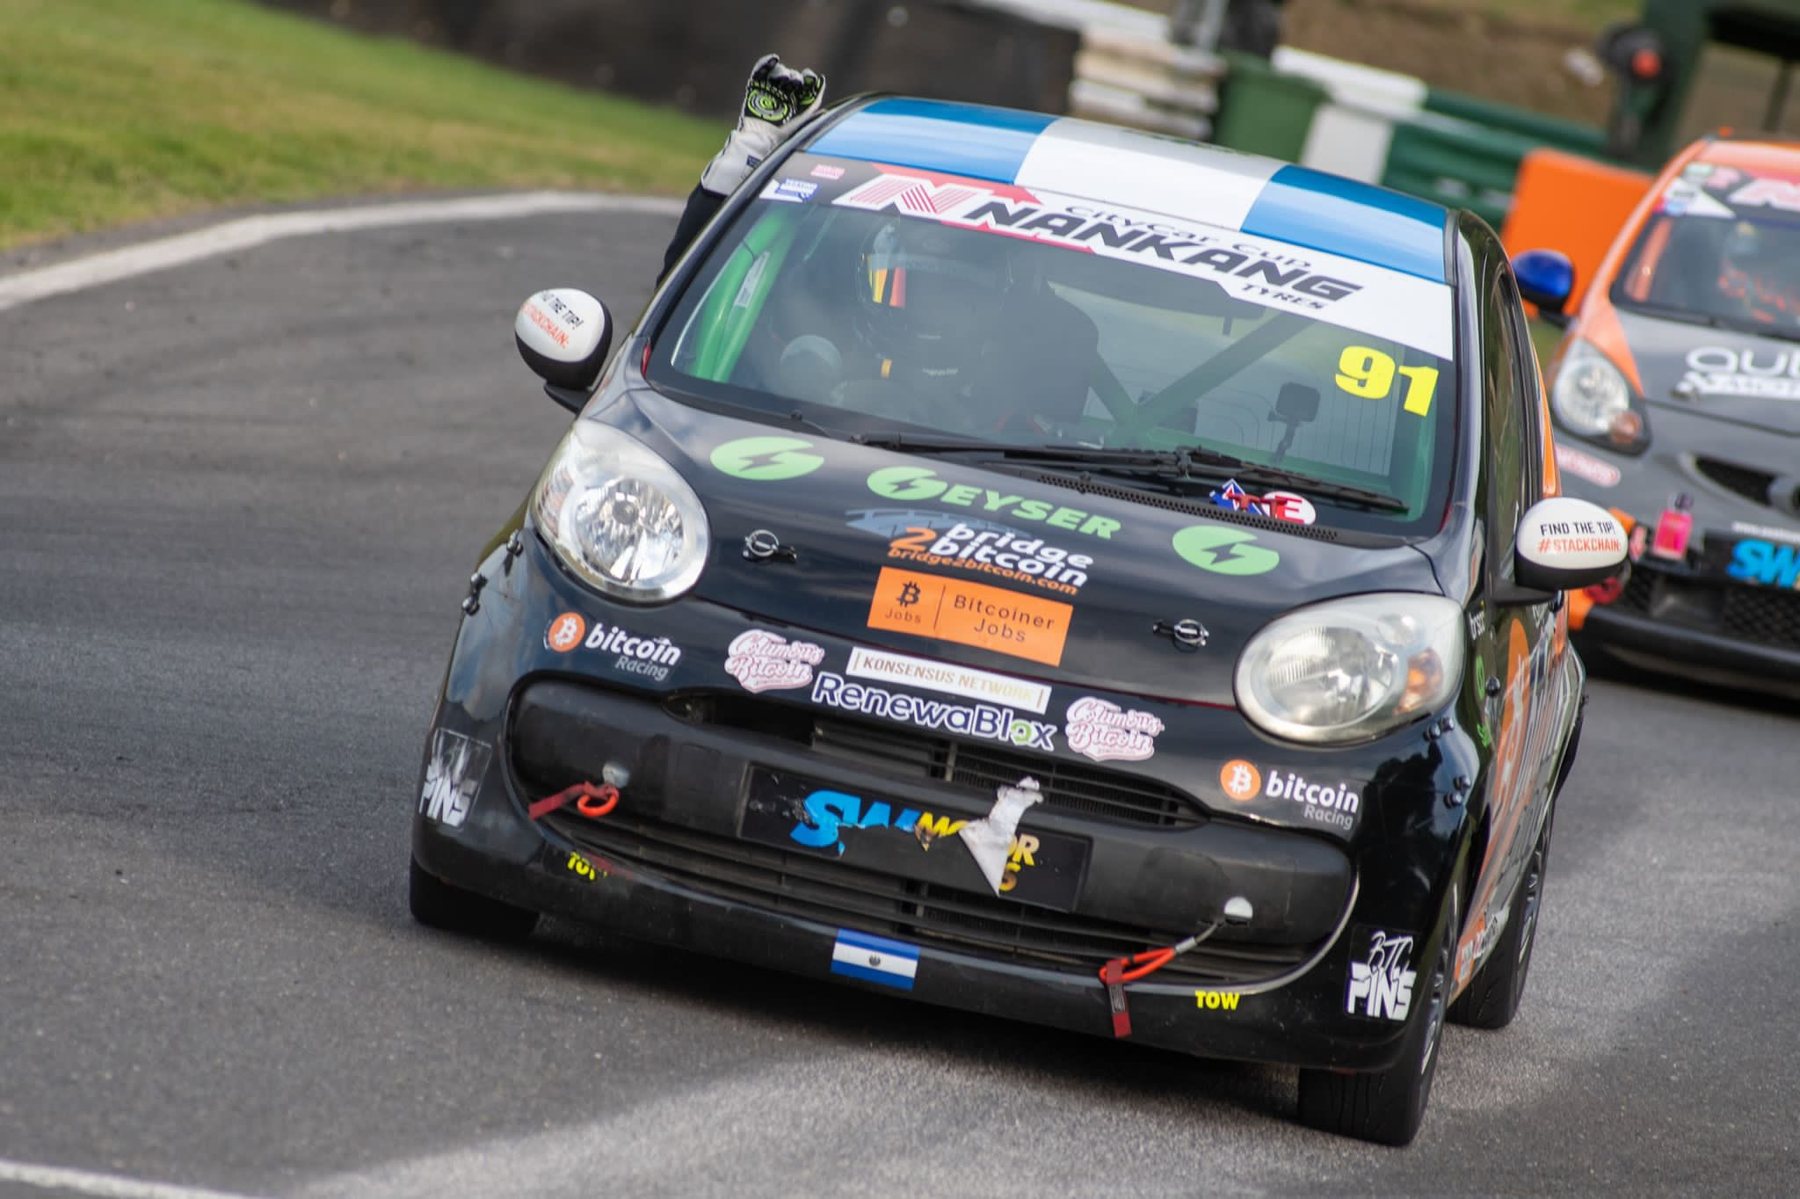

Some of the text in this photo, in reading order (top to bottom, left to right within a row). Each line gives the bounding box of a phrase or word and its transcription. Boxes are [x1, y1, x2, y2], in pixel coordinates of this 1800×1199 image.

[963, 199, 1365, 302] NANKANG
[1334, 345, 1439, 418] 91
[867, 466, 1122, 540] GEYSER
[946, 523, 1094, 569] bridge
[1540, 523, 1570, 535] FIND
[1573, 521, 1595, 534] THE
[888, 548, 1079, 596] bridge2bitcoin.com
[930, 537, 1088, 587] bitcoin
[884, 608, 922, 624] Jobs
[953, 594, 1055, 630] Bitcoiner
[974, 618, 1026, 643] Jobs
[585, 622, 681, 667] bitcoin
[615, 655, 669, 682] Racing
[863, 656, 1032, 702] KONSENSUS NETWORK
[812, 673, 1057, 750] RenewaBlox
[1266, 770, 1359, 813] bitcoin
[1304, 804, 1354, 830] Racing
[1368, 931, 1413, 975] BTC
[1195, 990, 1240, 1010] TOW
[1347, 961, 1417, 1021] PINS
